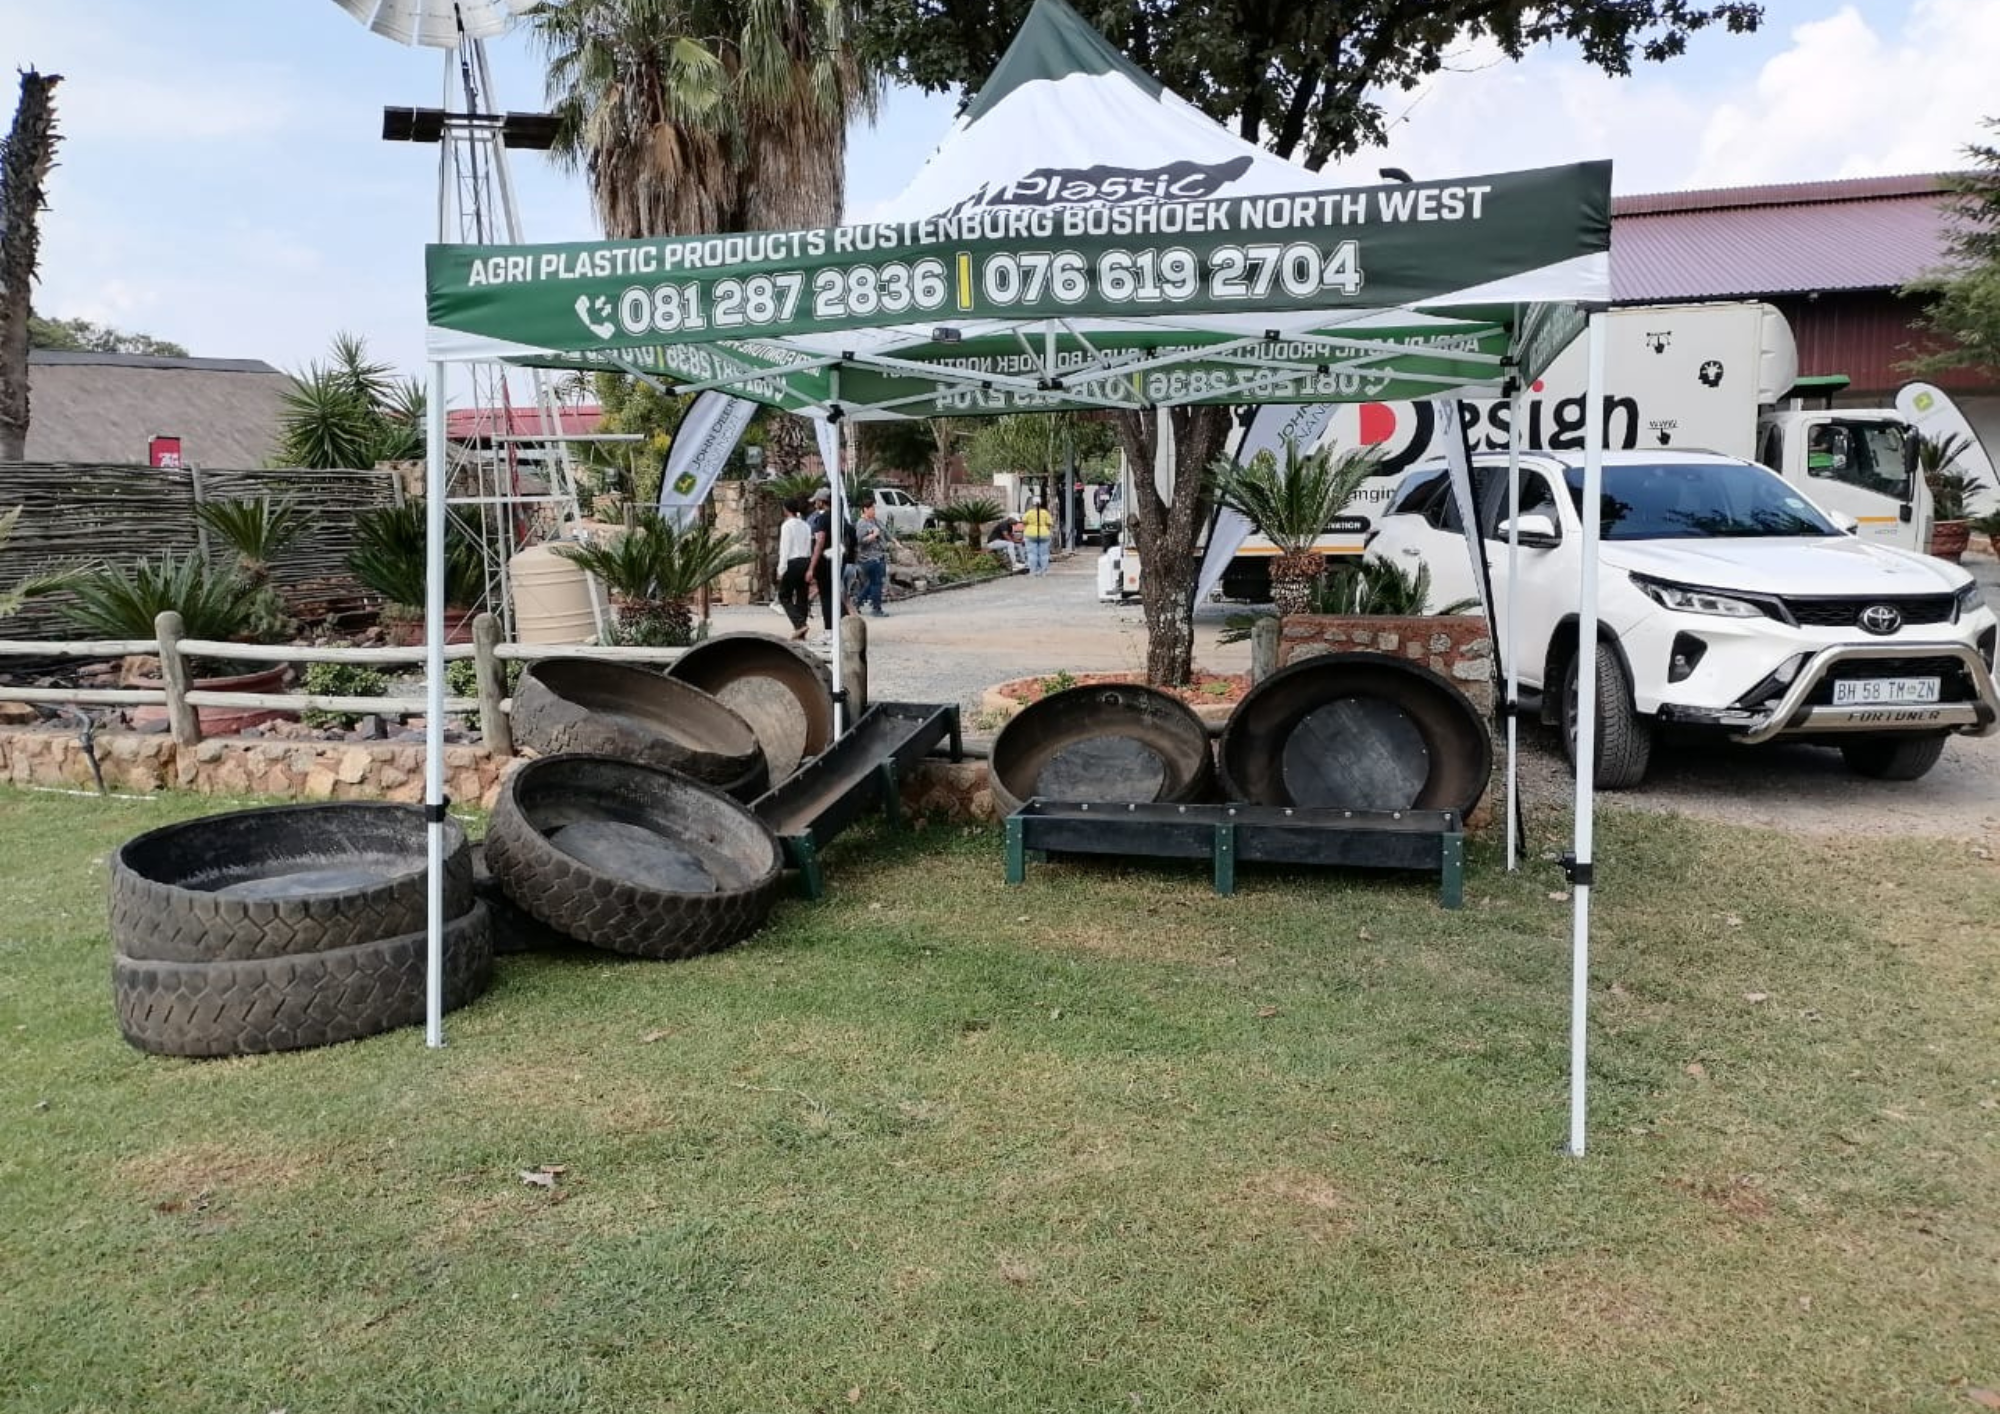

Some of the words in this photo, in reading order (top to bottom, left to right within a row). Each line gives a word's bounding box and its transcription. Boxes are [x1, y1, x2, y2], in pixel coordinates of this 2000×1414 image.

[1003, 173, 1206, 201] Plastic
[468, 259, 533, 287] AGRI
[540, 245, 658, 281] PLASTIC
[664, 229, 826, 270] PRODUCTS
[833, 207, 1054, 253] RUSTENBURG
[1063, 201, 1230, 237] BOSHOEK
[1239, 194, 1366, 230] NORTH
[1378, 185, 1492, 222] WEST
[619, 282, 706, 336] 081
[712, 271, 804, 329] 287
[813, 258, 947, 319] 2836
[983, 251, 1087, 304] 076
[1098, 246, 1200, 303] 619
[1208, 241, 1364, 300] 2704
[1837, 683, 1856, 701] BH
[1863, 682, 1881, 699] 58
[1888, 681, 1906, 699] TM
[1917, 681, 1935, 698] ZN
[1847, 710, 1941, 723] FORTUNER
